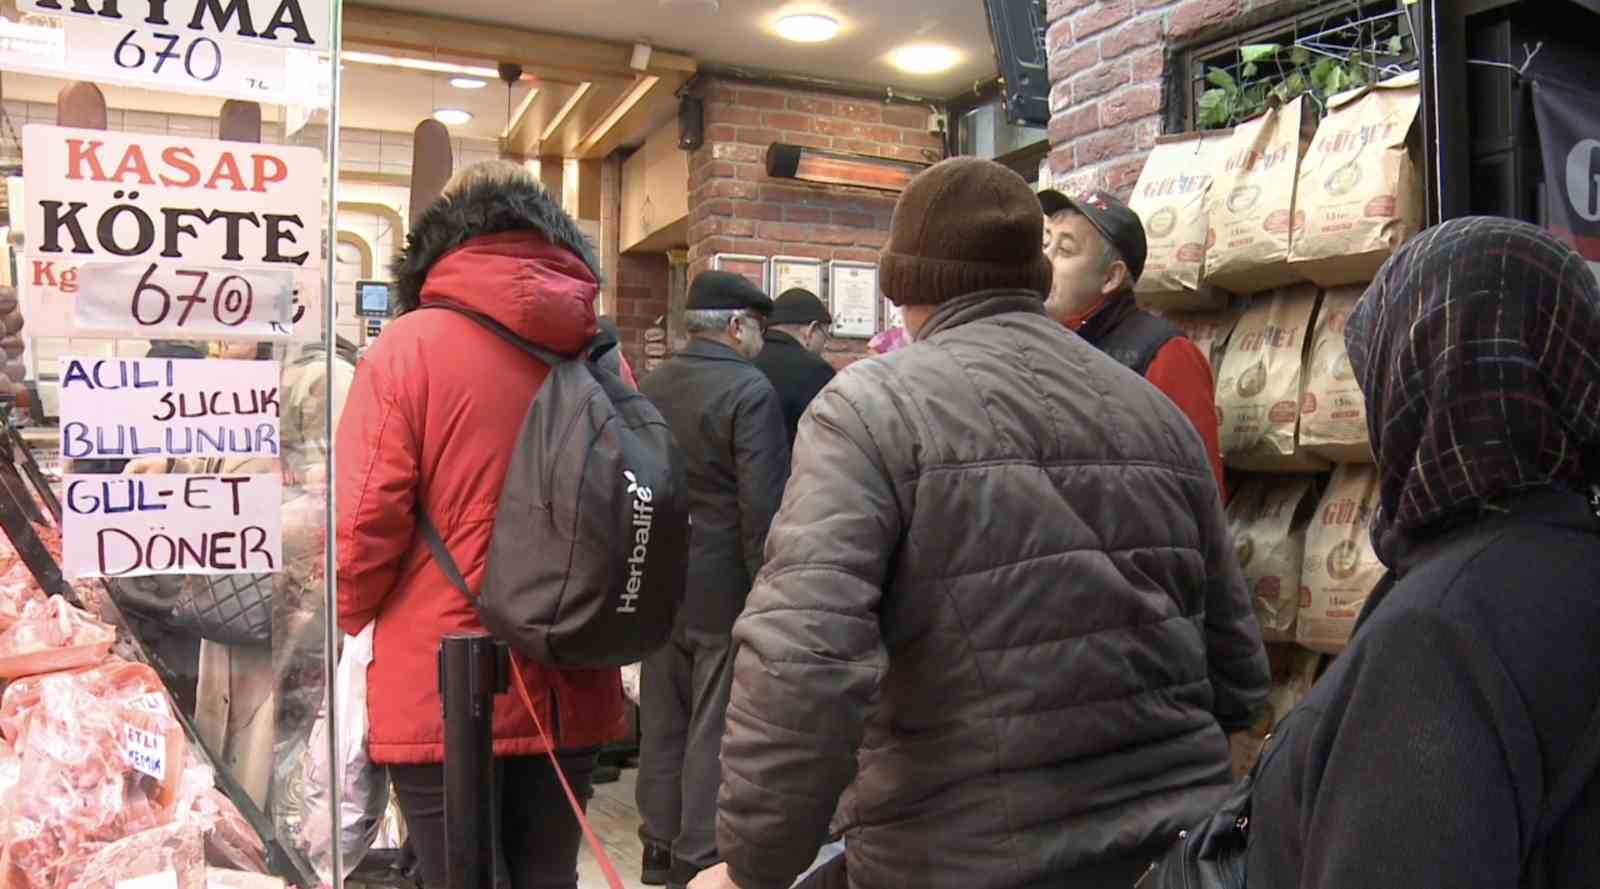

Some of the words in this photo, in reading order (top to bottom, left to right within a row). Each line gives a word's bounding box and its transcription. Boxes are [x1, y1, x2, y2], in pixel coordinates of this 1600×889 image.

[113, 29, 223, 82] 670
[64, 138, 289, 193] KASAP
[38, 189, 310, 266] KÖFTE
[32, 260, 79, 293] Kg
[131, 262, 253, 327] 670
[62, 359, 174, 390] ACILI
[152, 387, 281, 421] SUCUK
[62, 421, 279, 458] BULUNUR
[66, 475, 251, 516] GÜL-ET
[97, 525, 275, 576] DÖNER
[615, 486, 653, 613] Herbalife
